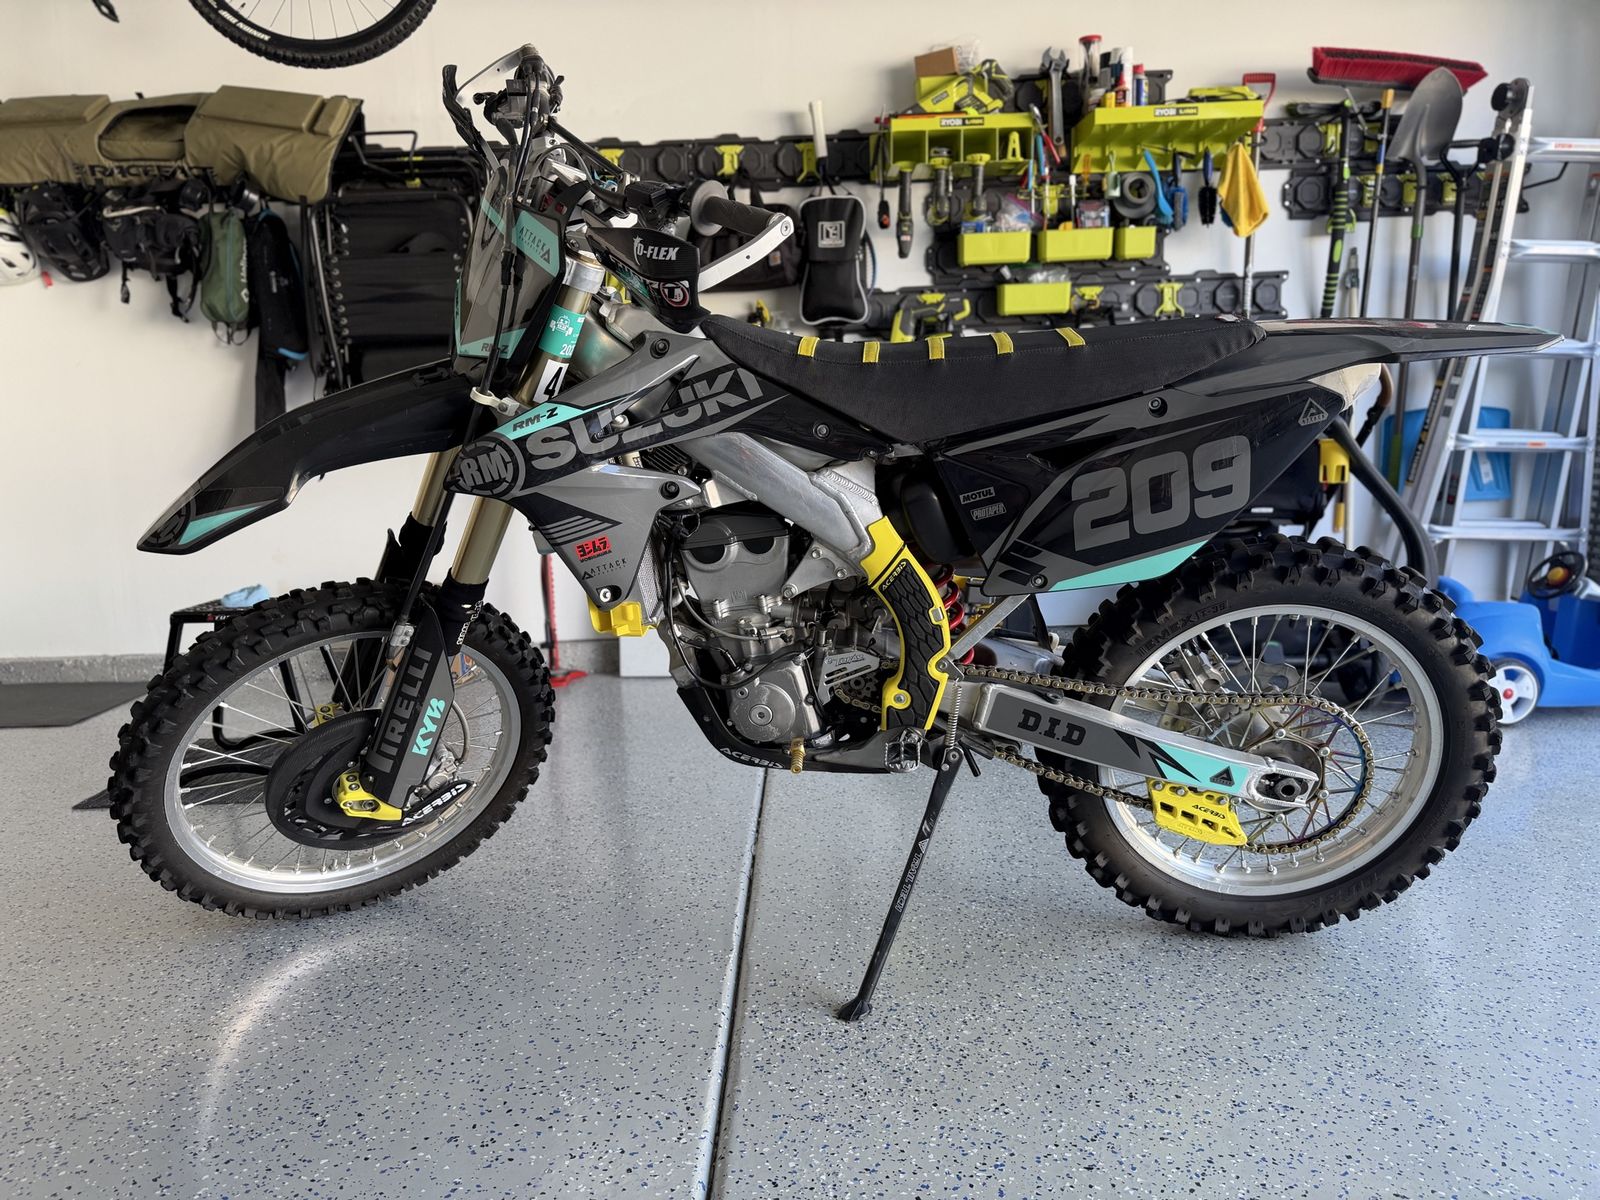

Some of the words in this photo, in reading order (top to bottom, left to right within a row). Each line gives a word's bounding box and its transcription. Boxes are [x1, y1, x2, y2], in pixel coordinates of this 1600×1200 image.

[543, 366, 564, 400] 4
[512, 406, 559, 433] RM-Z
[962, 488, 994, 503] MOTUL
[1071, 434, 1252, 552] 209
[590, 557, 627, 575] ATTACK
[412, 697, 446, 757] KYB
[1017, 708, 1087, 747] D.I.D
[719, 747, 785, 769] ACERBIS
[402, 782, 469, 827] ACERBIS
[1191, 804, 1227, 820] ACERBIS
